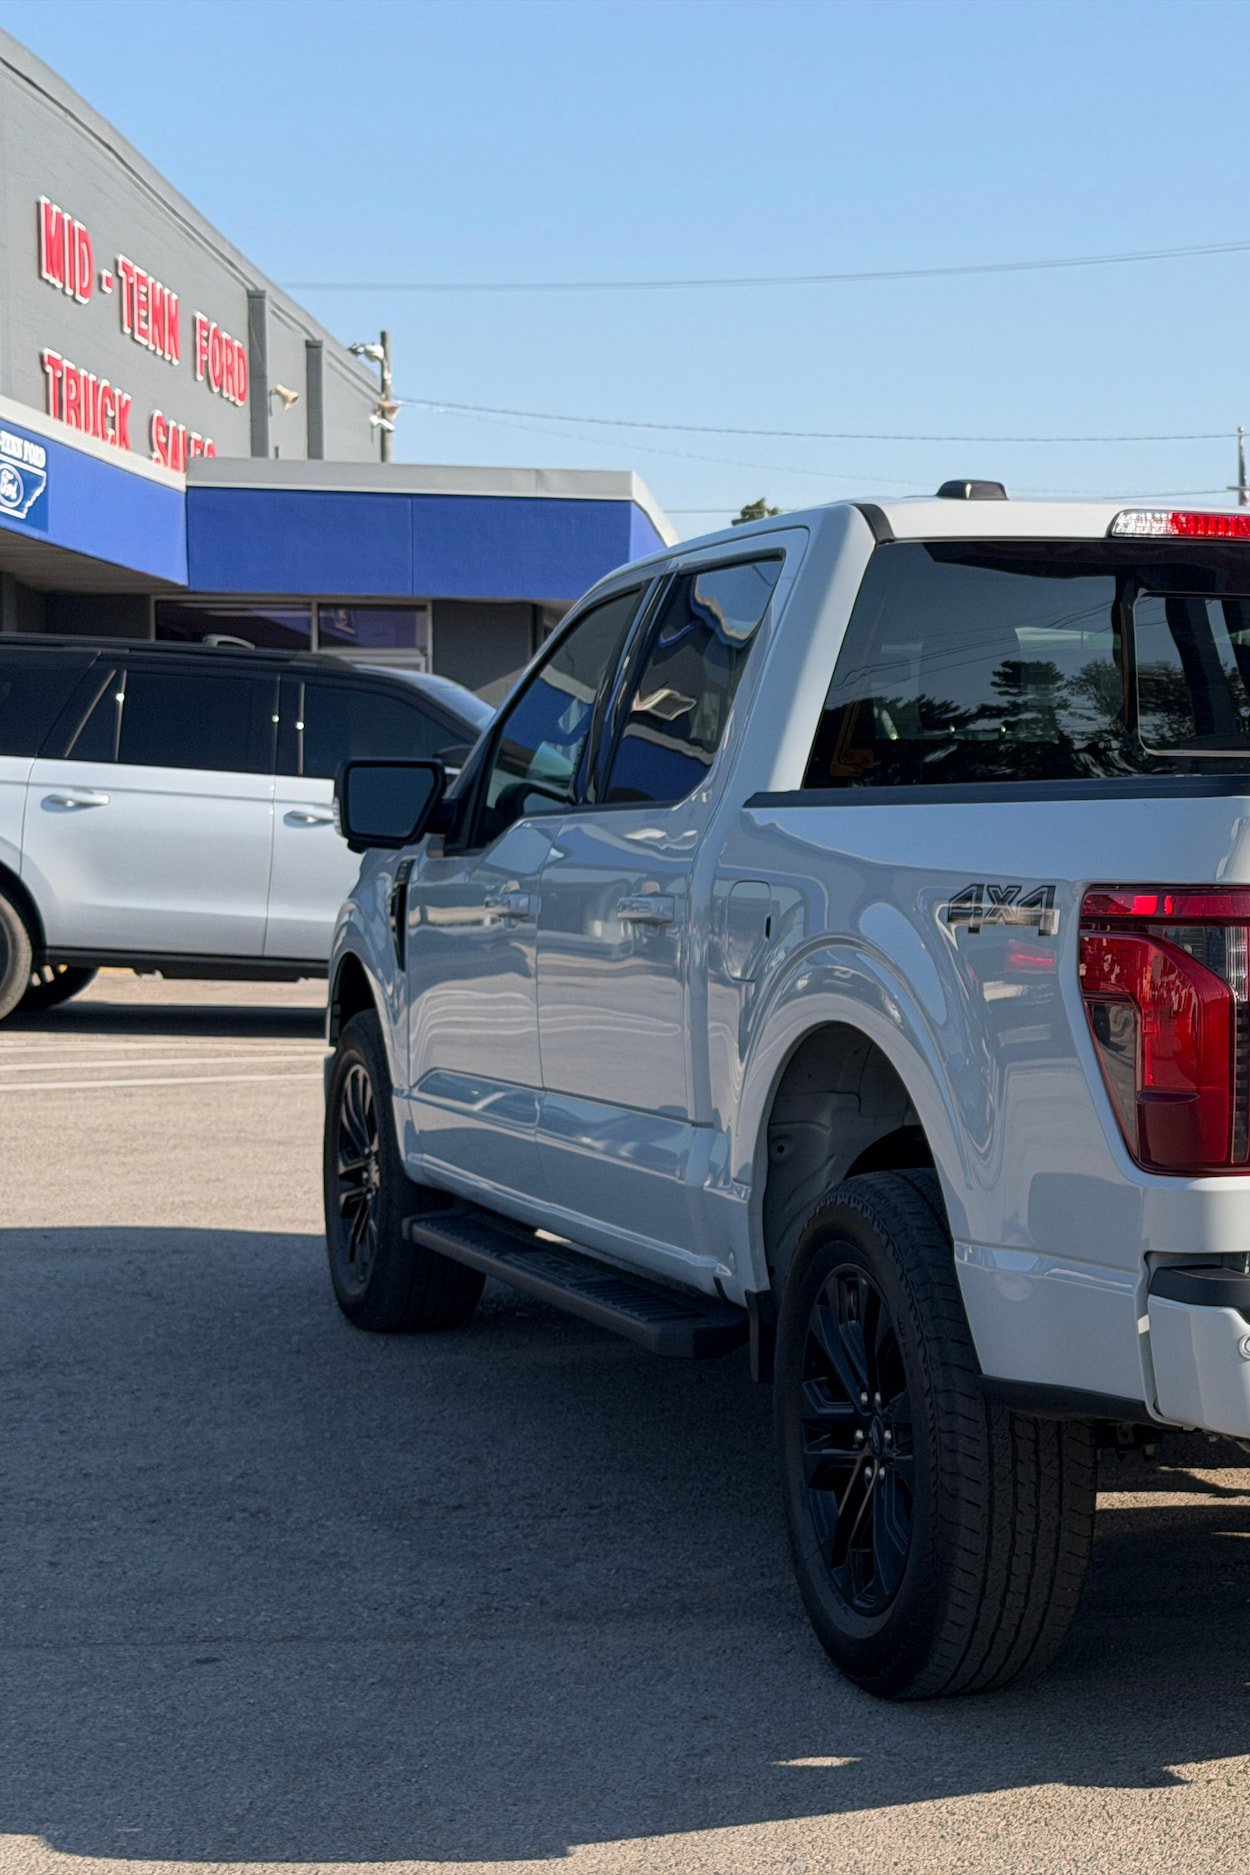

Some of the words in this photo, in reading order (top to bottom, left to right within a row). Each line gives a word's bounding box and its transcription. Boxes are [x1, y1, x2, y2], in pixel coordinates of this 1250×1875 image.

[38, 195, 94, 304] MID
[115, 254, 180, 365] TENN
[194, 310, 248, 407] FORD
[43, 347, 132, 451] TRUCK
